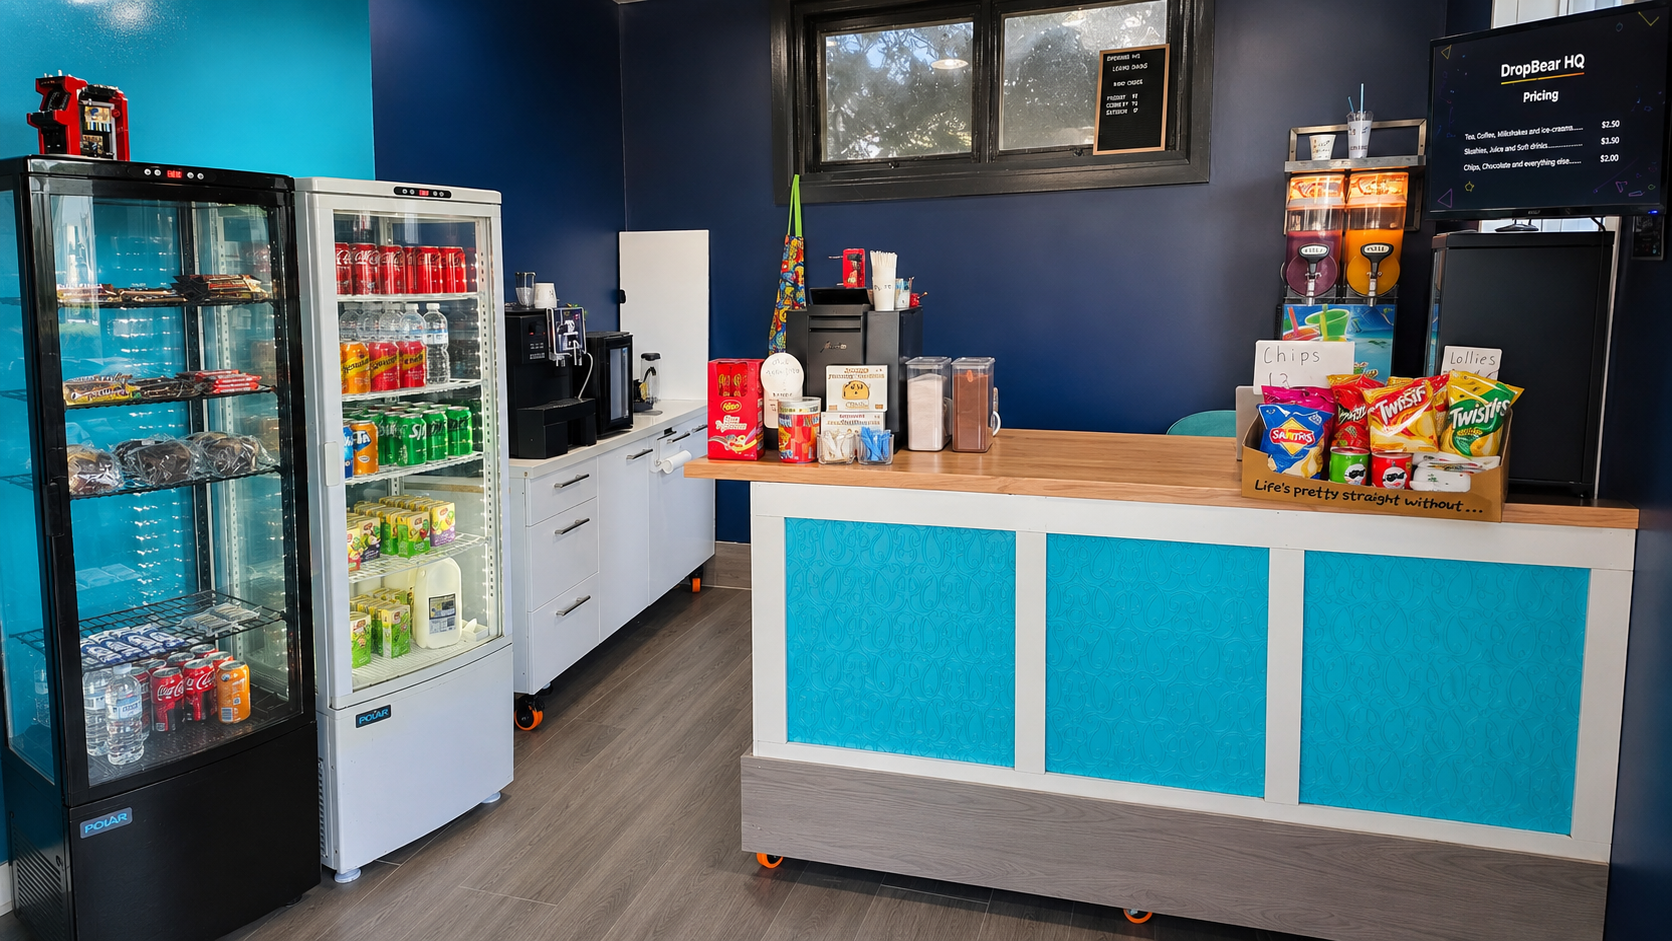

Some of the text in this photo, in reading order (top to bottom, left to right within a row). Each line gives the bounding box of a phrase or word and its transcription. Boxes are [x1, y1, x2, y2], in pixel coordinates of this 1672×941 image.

[1501, 53, 1585, 78] DropBear HQ
[1523, 89, 1559, 103] Pricing
[1601, 120, 1620, 129] $2.50
[1489, 145, 1504, 153] Juice
[1504, 144, 1517, 152] and
[1517, 143, 1529, 151] Soft
[1463, 163, 1481, 172] Chips,
[1481, 161, 1511, 170] Chocolate
[1512, 160, 1524, 168] and
[1524, 158, 1556, 168] everything
[1600, 154, 1619, 163] $2.00
[1263, 345, 1321, 366] Chips
[1450, 350, 1496, 366] Lollies
[1255, 479, 1291, 494] Life's
[1293, 486, 1339, 501] pretty
[1342, 490, 1401, 506] straight
[358, 708, 389, 725] POLAR
[84, 812, 128, 834] POLAR
